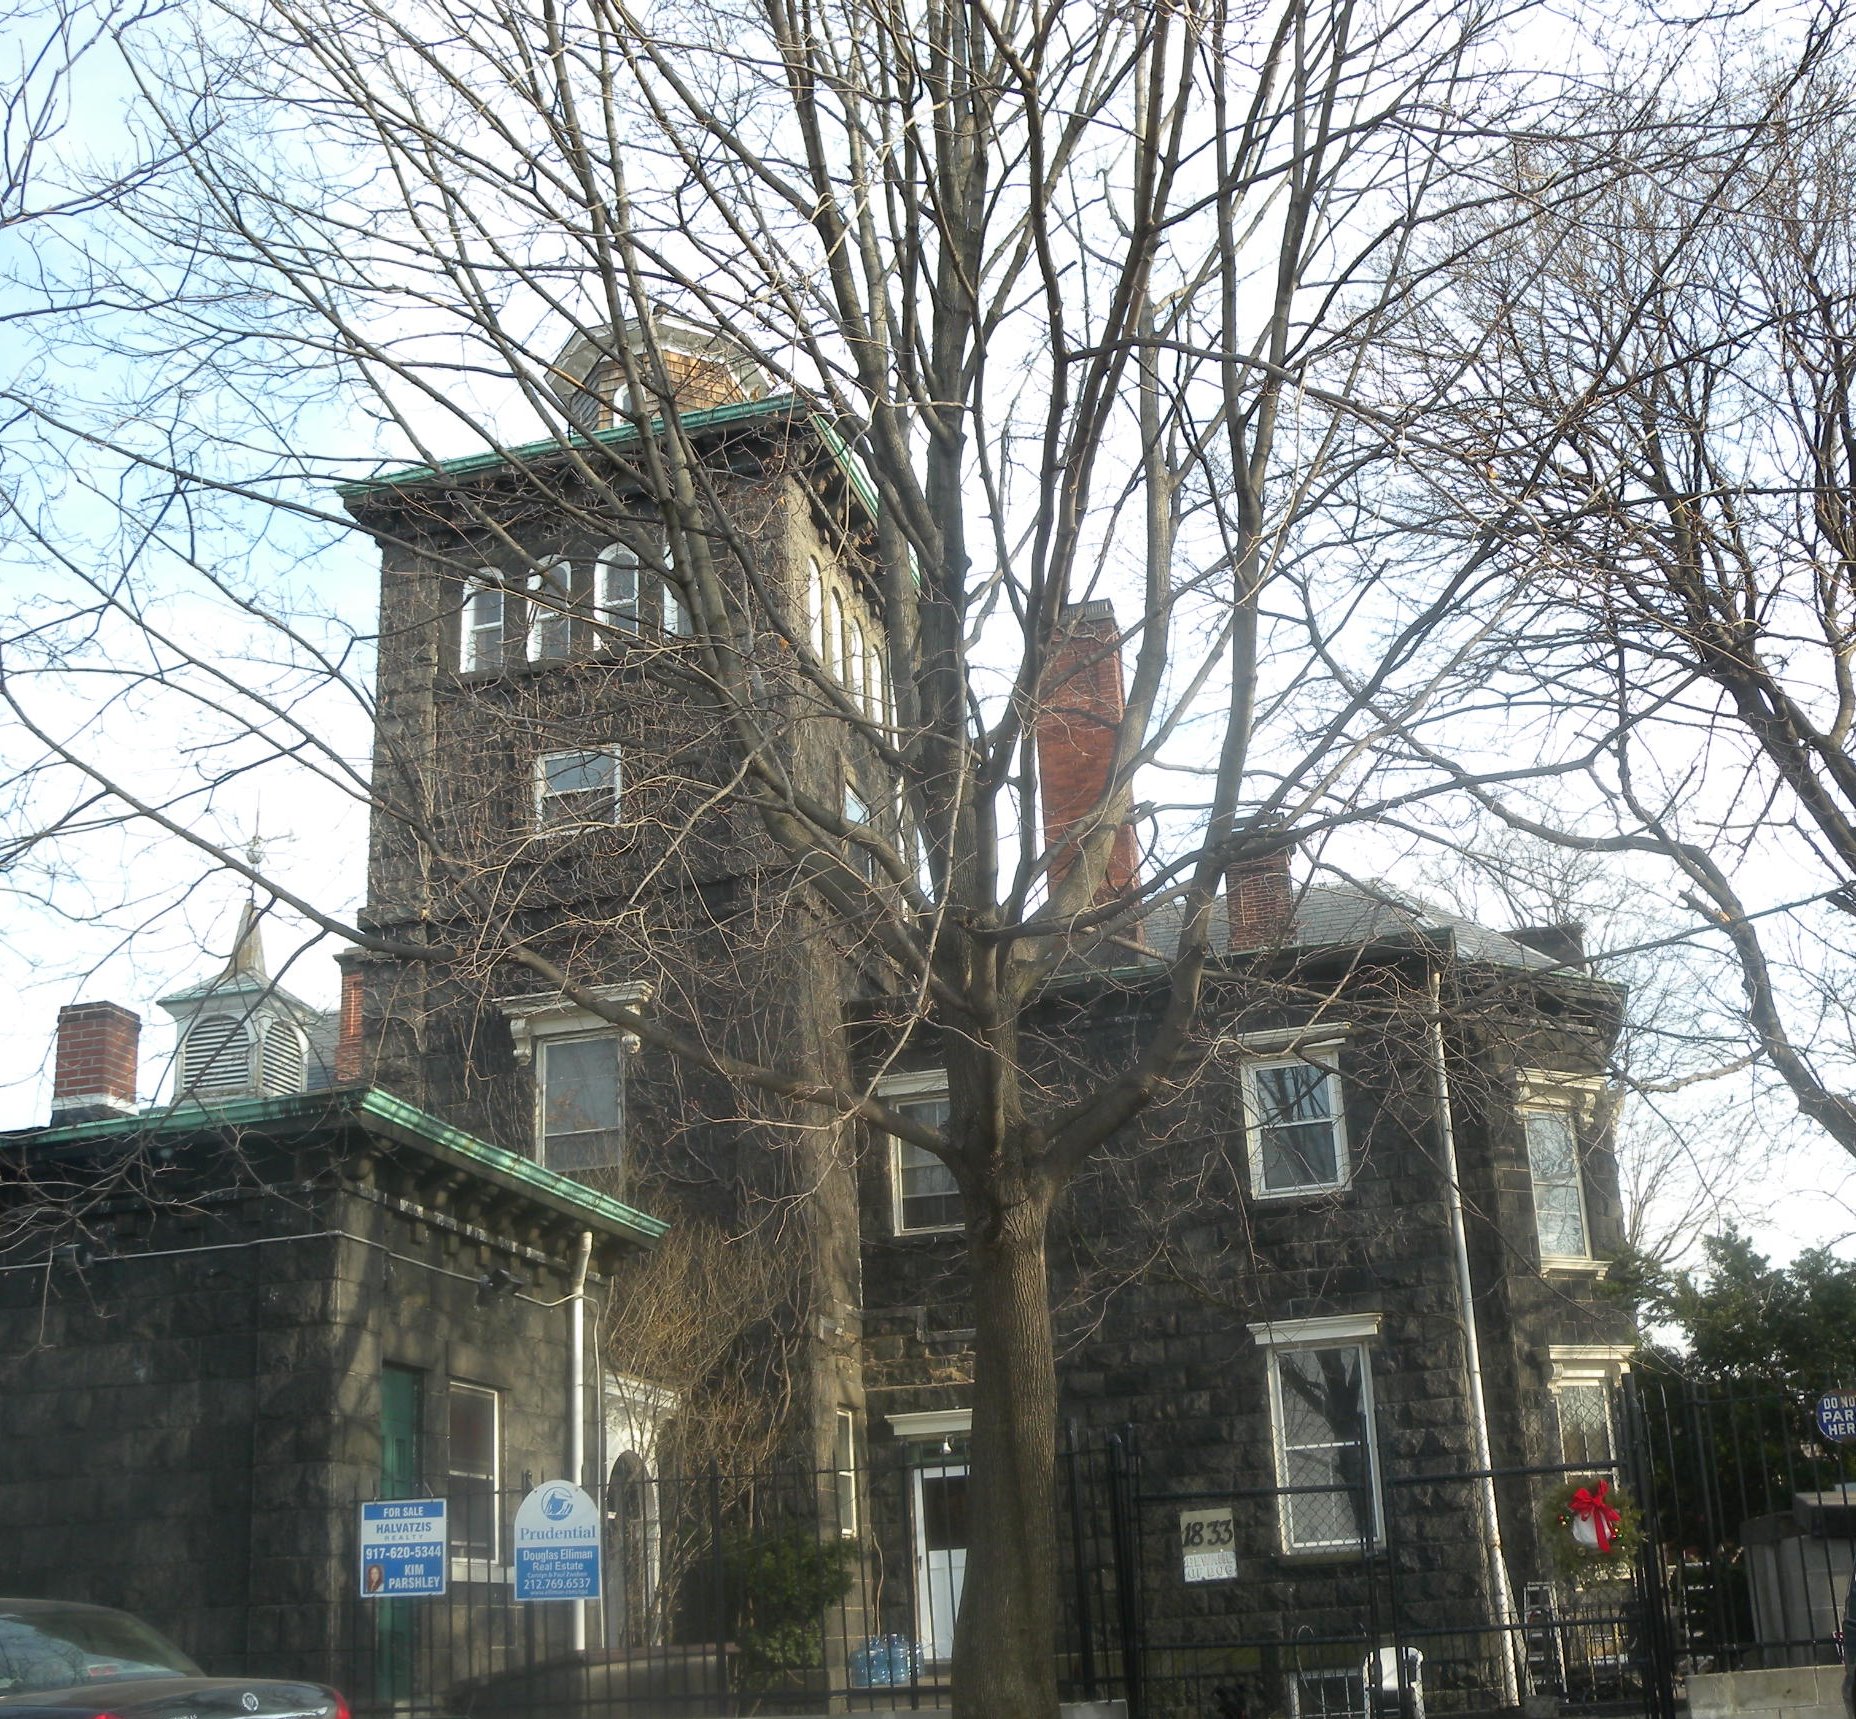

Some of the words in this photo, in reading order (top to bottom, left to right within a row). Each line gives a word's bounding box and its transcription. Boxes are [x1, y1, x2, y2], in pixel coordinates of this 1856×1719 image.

[1823, 1397, 1838, 1410] DO
[1840, 1396, 1856, 1409] NO
[1822, 1409, 1855, 1423] PAR
[1828, 1422, 1856, 1436] HER
[383, 1508, 400, 1517] FOR
[403, 1506, 424, 1517] SALE
[376, 1522, 432, 1534] HALVATZIS
[520, 1525, 597, 1541] Prudential
[1182, 1519, 1234, 1547] 1833
[365, 1545, 442, 1560] 917-620-5344
[523, 1549, 559, 1563] Douglas
[560, 1548, 593, 1561] Elliman
[404, 1564, 425, 1576] KIM
[532, 1562, 553, 1571] Real
[555, 1561, 584, 1571] Estate
[388, 1576, 440, 1589] PARSHLEY
[524, 1577, 591, 1590] 212.769.6537
